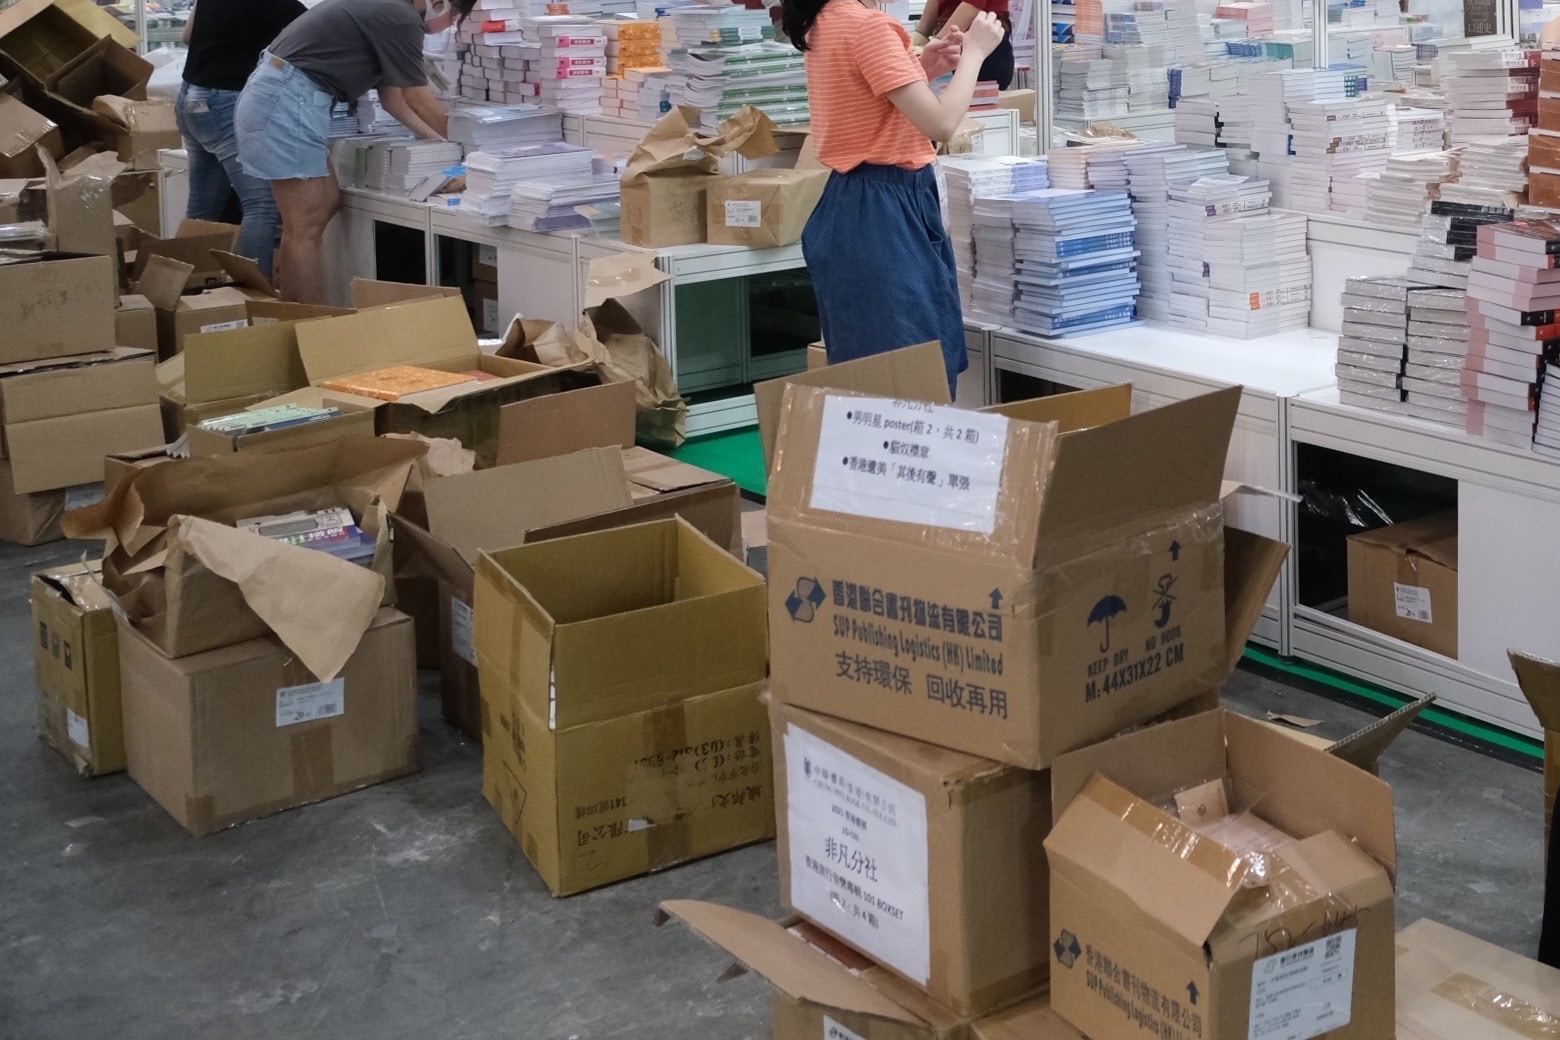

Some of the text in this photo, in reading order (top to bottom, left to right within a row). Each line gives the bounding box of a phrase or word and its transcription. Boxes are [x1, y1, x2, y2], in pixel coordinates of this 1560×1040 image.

[832, 579, 1003, 642] 香港聯合書刊物流有限公司
[833, 614, 1003, 676] SUP Publishing Logistics (HK) Limited
[1088, 648, 1129, 677] KEEP DRY
[1166, 642, 1184, 667] CM
[835, 651, 1008, 719] 支持環保 回收再用
[711, 785, 762, 807] 城邦文
[824, 837, 878, 883] 非凡分社
